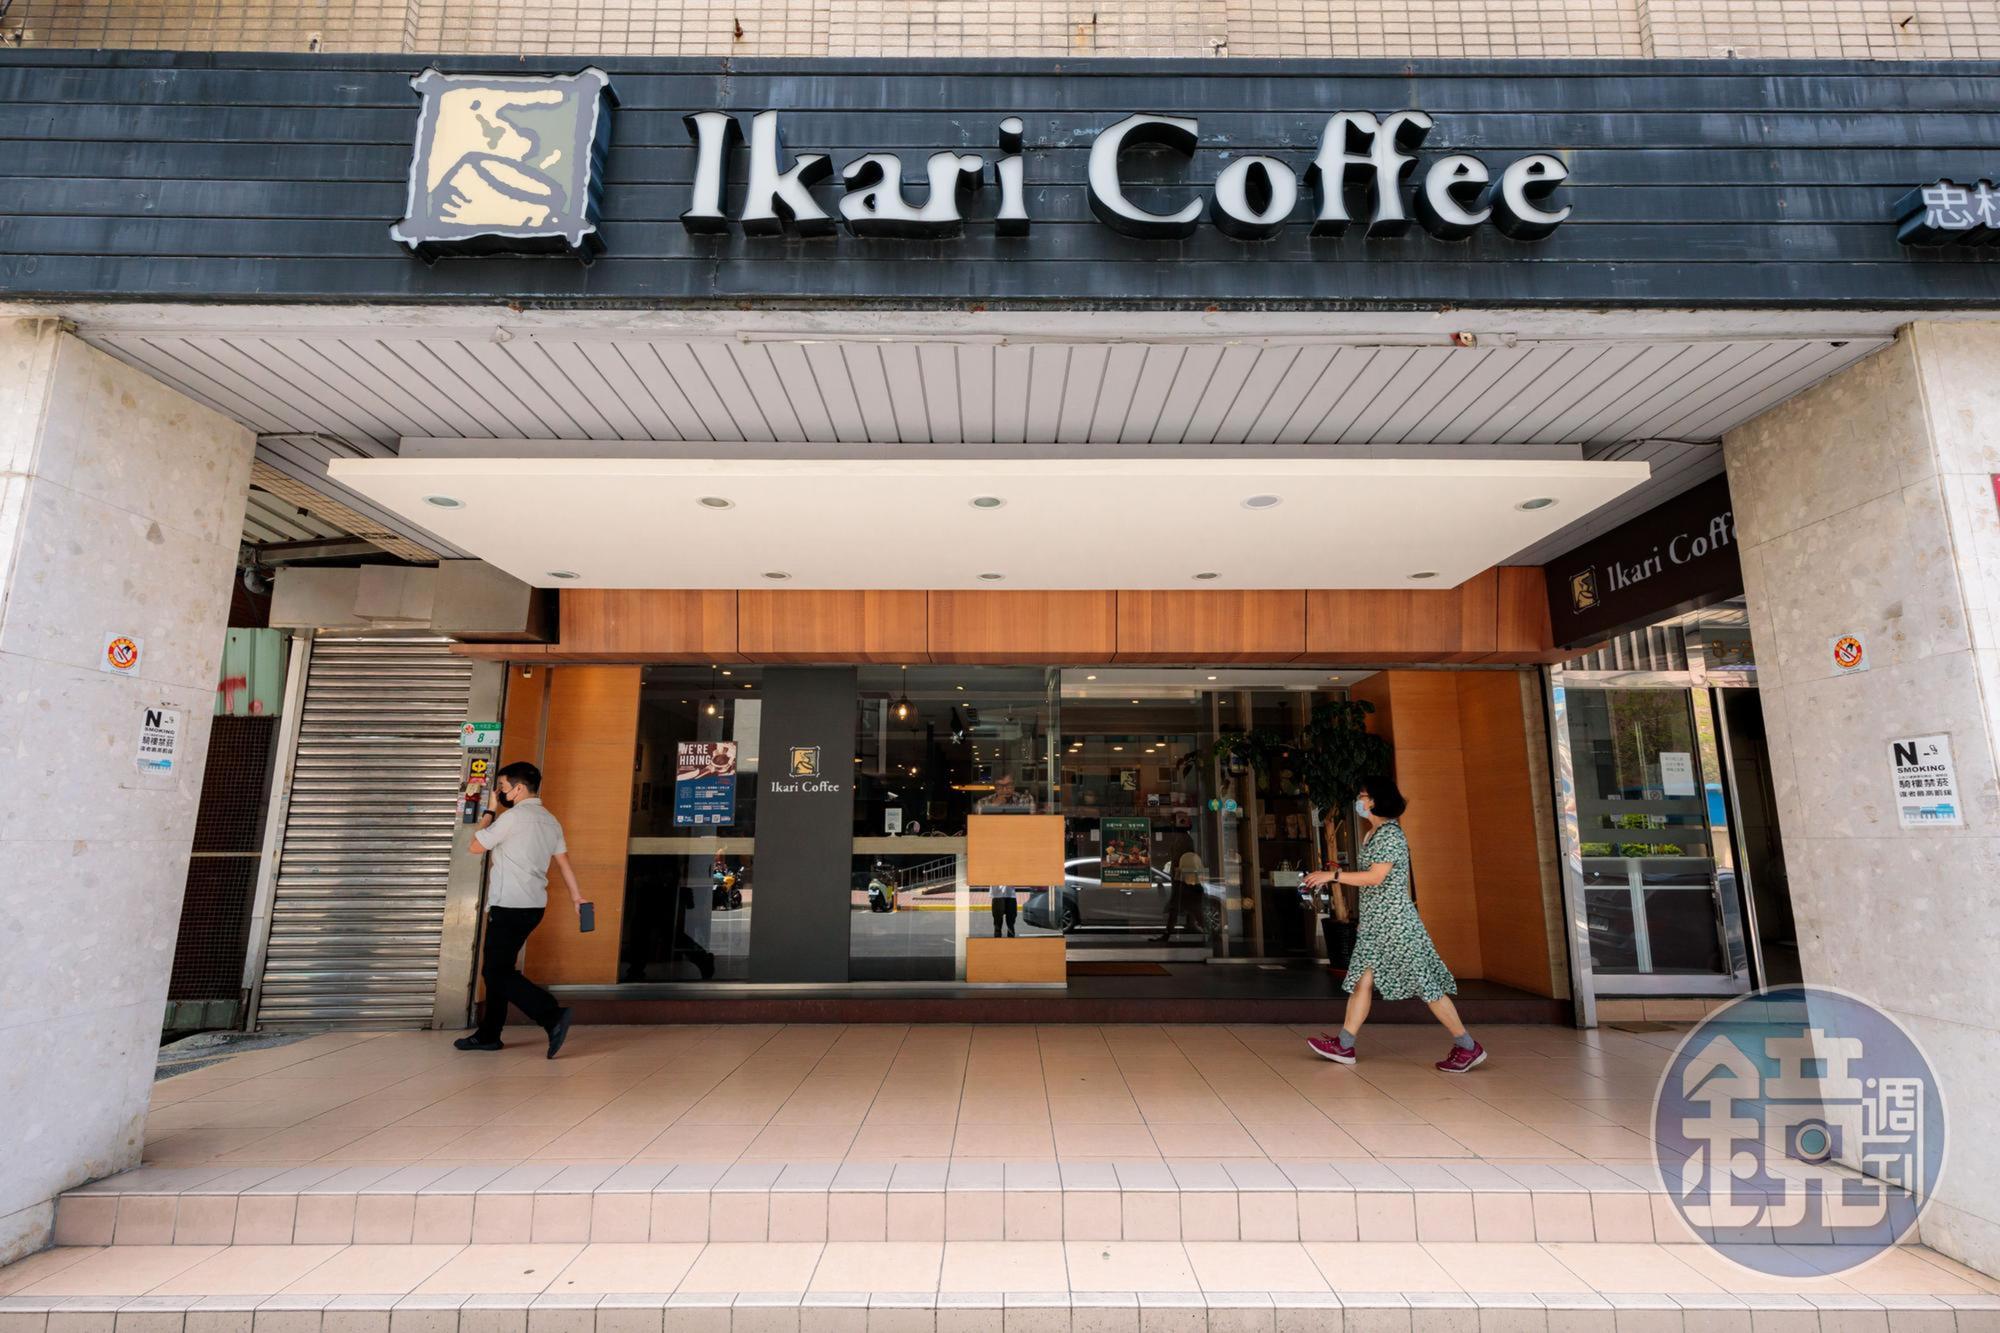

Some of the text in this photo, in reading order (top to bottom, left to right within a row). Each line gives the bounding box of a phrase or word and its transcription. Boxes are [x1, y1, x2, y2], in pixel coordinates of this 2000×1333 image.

[682, 110, 1572, 232] Ikari Coffee
[1606, 546, 1663, 592] Ikari
[477, 733, 485, 743] 8
[679, 744, 709, 754] WE'RE
[679, 755, 711, 765] HIRING
[1897, 764, 1946, 774] SMOKING
[771, 781, 840, 792] Ikari Coffee
